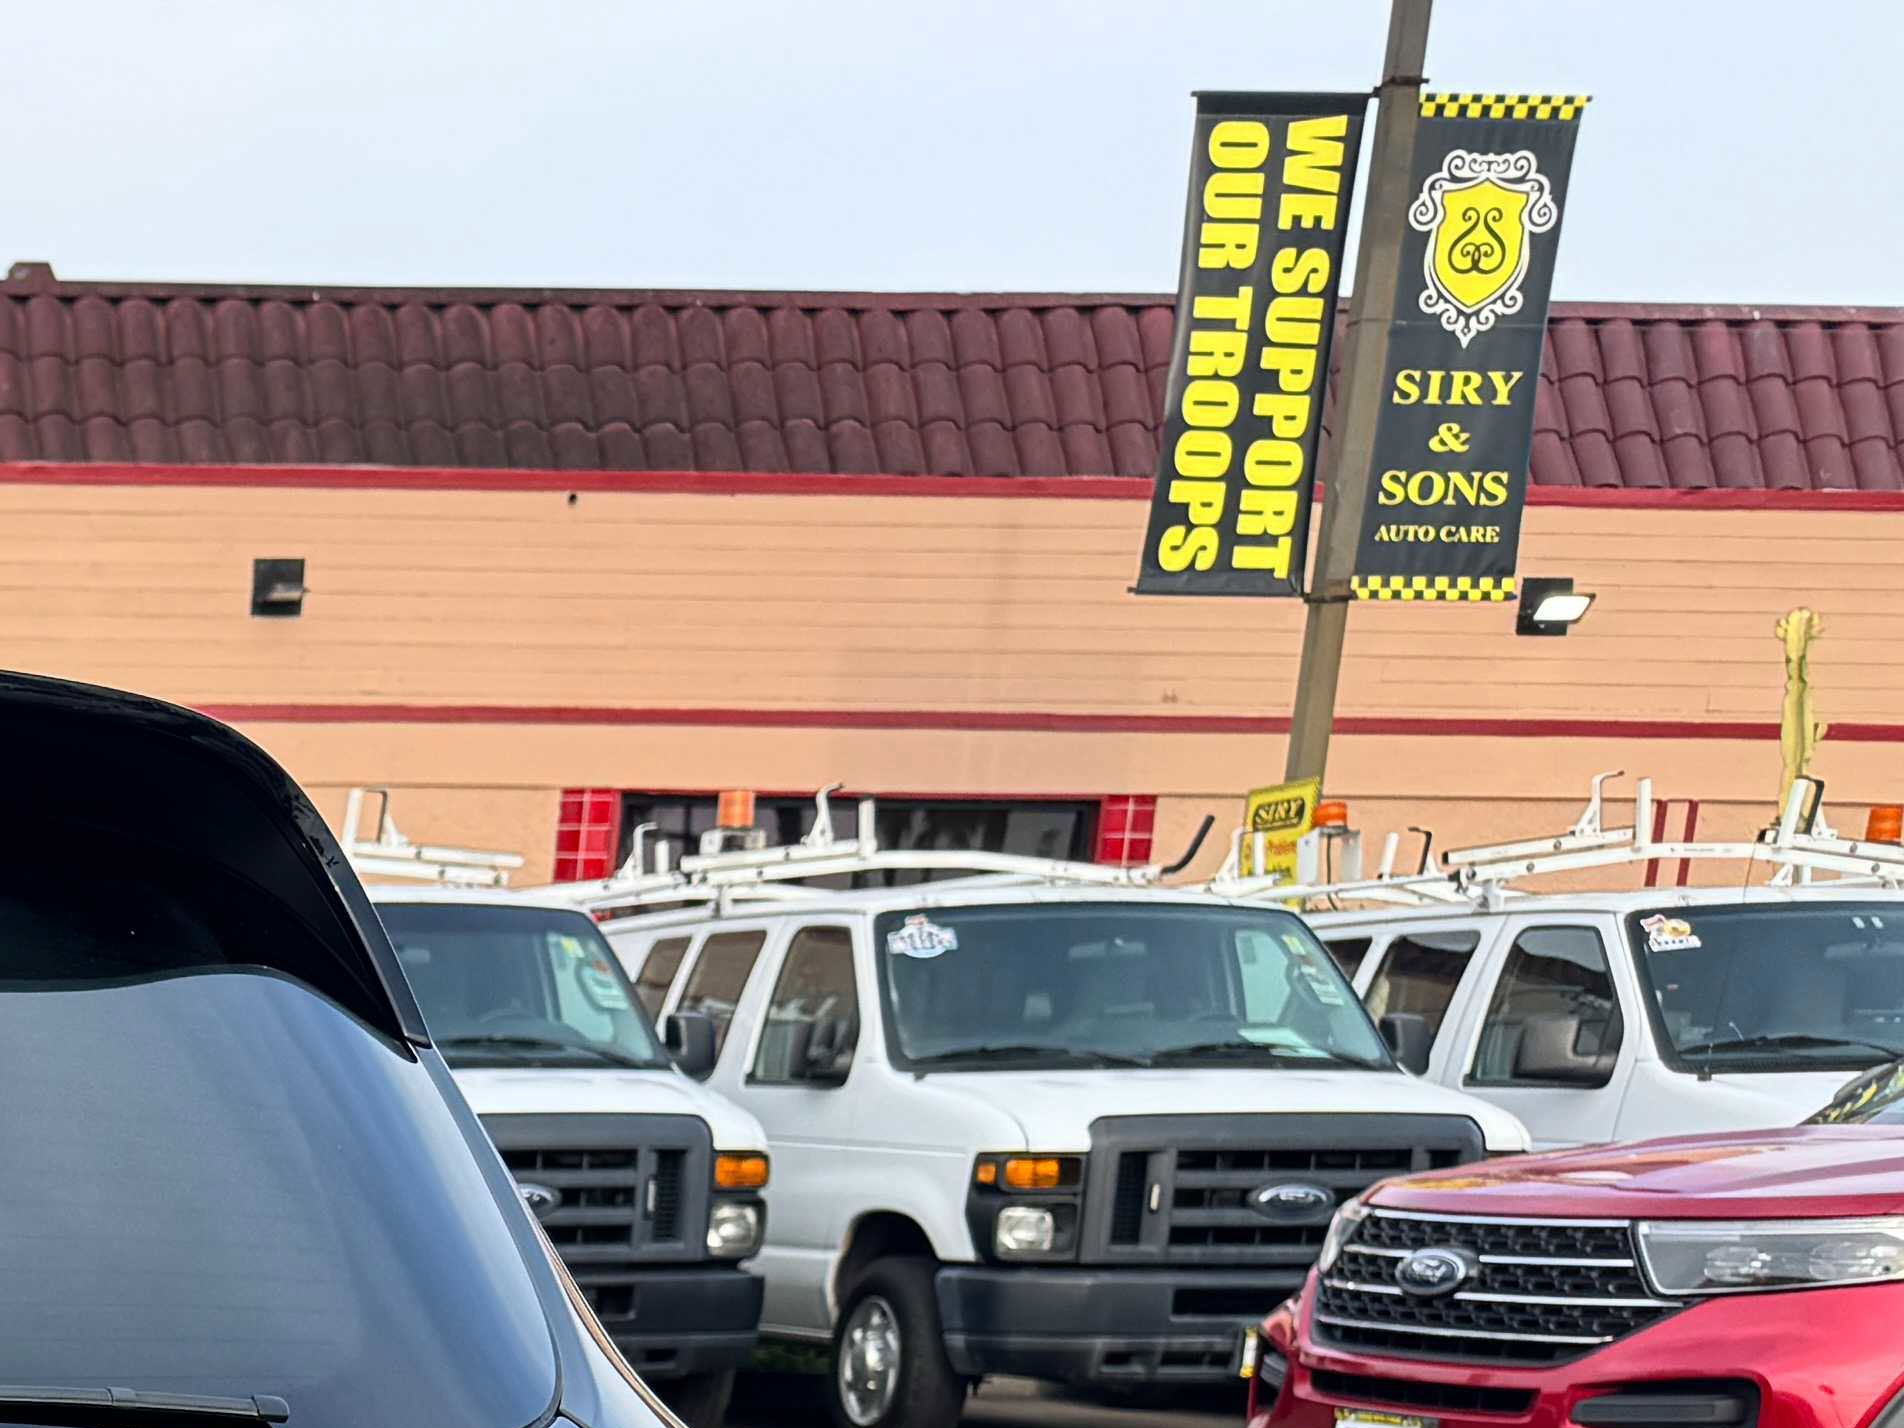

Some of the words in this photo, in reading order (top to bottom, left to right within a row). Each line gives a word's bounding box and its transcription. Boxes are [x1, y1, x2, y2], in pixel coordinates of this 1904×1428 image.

[1197, 119, 1271, 270] OUR
[1277, 114, 1349, 231] WE
[1231, 246, 1331, 580] SUPPORT
[1392, 367, 1524, 407] SIRY
[1157, 285, 1254, 573] TROOPS
[1428, 422, 1472, 453] &
[1377, 470, 1510, 508] SONS
[1373, 523, 1436, 544] AUTO
[1438, 523, 1500, 544] CARE
